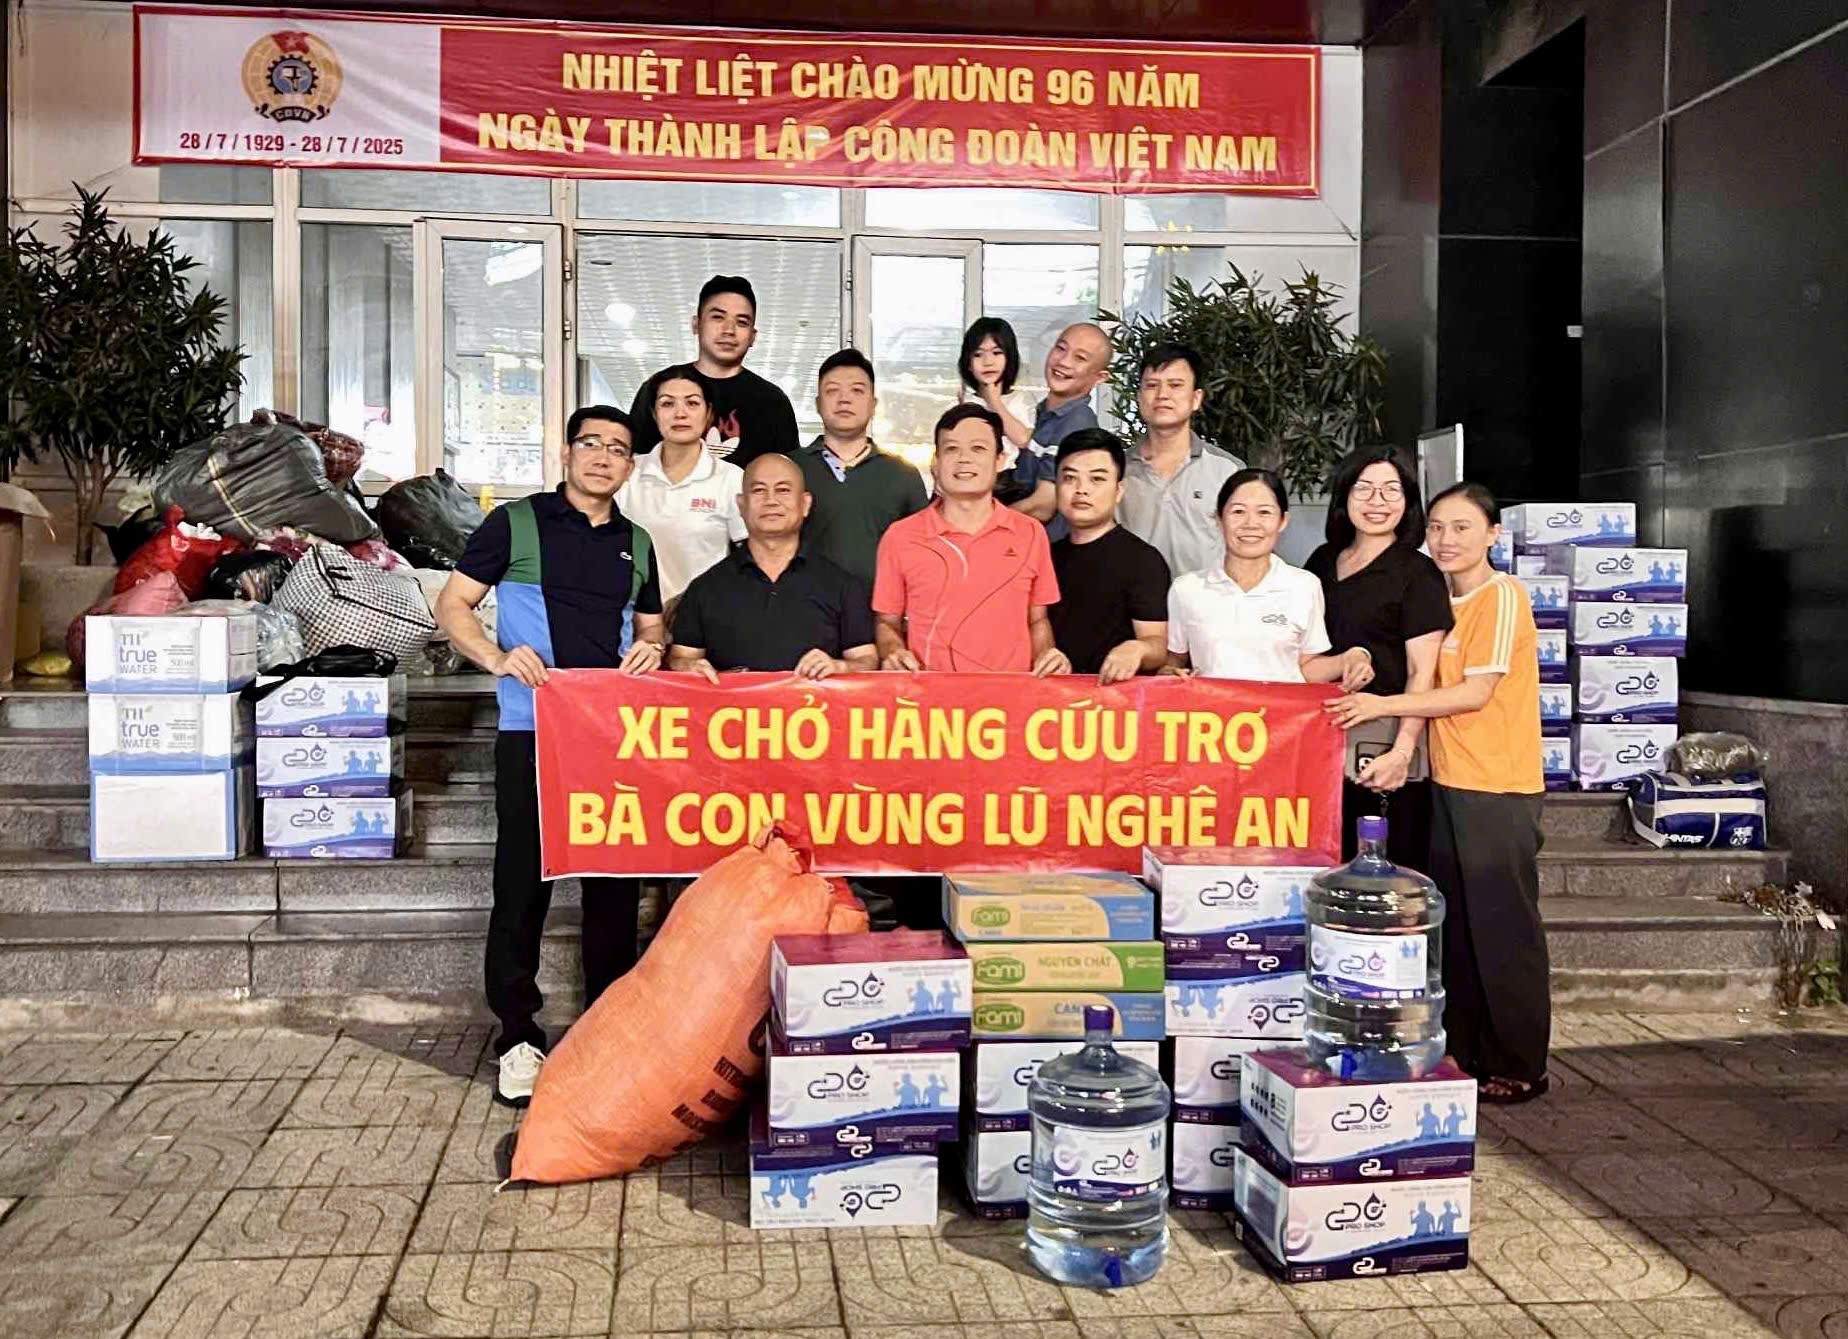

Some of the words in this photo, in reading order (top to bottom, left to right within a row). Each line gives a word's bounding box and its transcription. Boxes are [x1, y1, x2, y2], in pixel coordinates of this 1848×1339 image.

[562, 50, 685, 100] NHIỆT
[697, 52, 778, 104] LIỆT
[791, 55, 899, 101] CHÀO
[913, 59, 1033, 105] MỪNG
[1047, 70, 1094, 106] 96
[1108, 64, 1200, 109] NĂM
[478, 109, 592, 154] NGÀY
[605, 114, 741, 159] THÀNH
[754, 117, 830, 169] LẬP
[844, 119, 954, 165] CÔNG
[967, 124, 1076, 169] ĐOÀN
[1185, 134, 1277, 172] NAM
[119, 646, 158, 663] true
[120, 664, 158, 674] WATER
[121, 721, 160, 738] true
[121, 738, 160, 749] WATER
[616, 705, 691, 760] XE
[706, 693, 831, 761] CHỞ
[848, 696, 1007, 761] HÀNG
[1024, 699, 1139, 763] CỨU
[1155, 706, 1268, 771] TRỢ
[568, 781, 648, 846] BÀ
[664, 792, 786, 846] CON
[803, 782, 964, 847] VÙNG
[983, 785, 1049, 847] LŨ
[1232, 795, 1310, 848] AN
